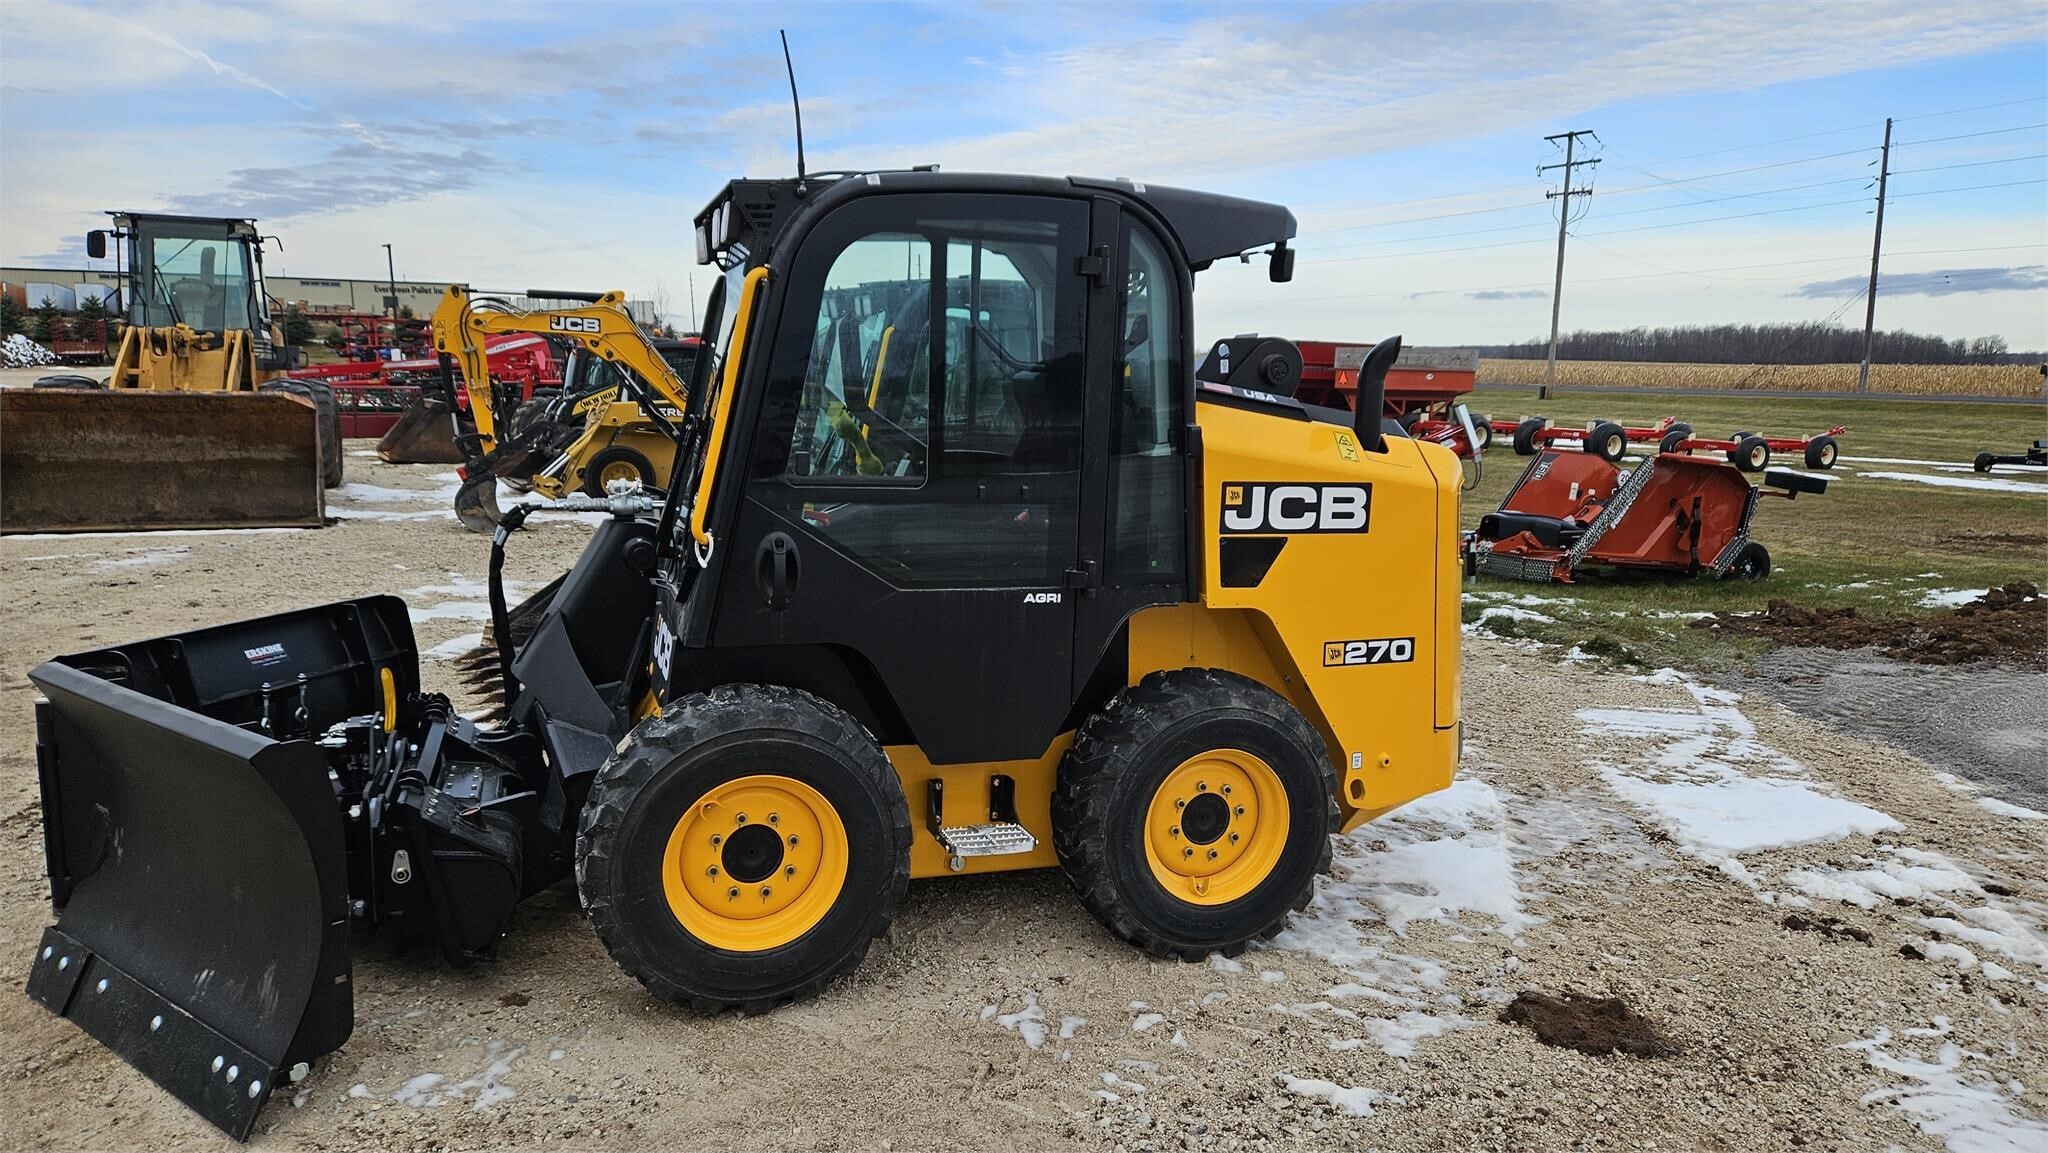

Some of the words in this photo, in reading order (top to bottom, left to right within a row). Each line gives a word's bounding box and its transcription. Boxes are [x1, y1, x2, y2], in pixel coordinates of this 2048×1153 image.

[411, 285, 432, 294] Pallet
[551, 316, 600, 332] JCB
[582, 397, 600, 408] NEW
[1243, 389, 1277, 402] USA
[638, 406, 684, 416] DERE
[1224, 486, 1367, 530] JCB
[1023, 593, 1061, 604] AGRI
[244, 643, 284, 659] ERSKINE
[654, 620, 673, 681] JCB
[1345, 639, 1412, 664] 270
